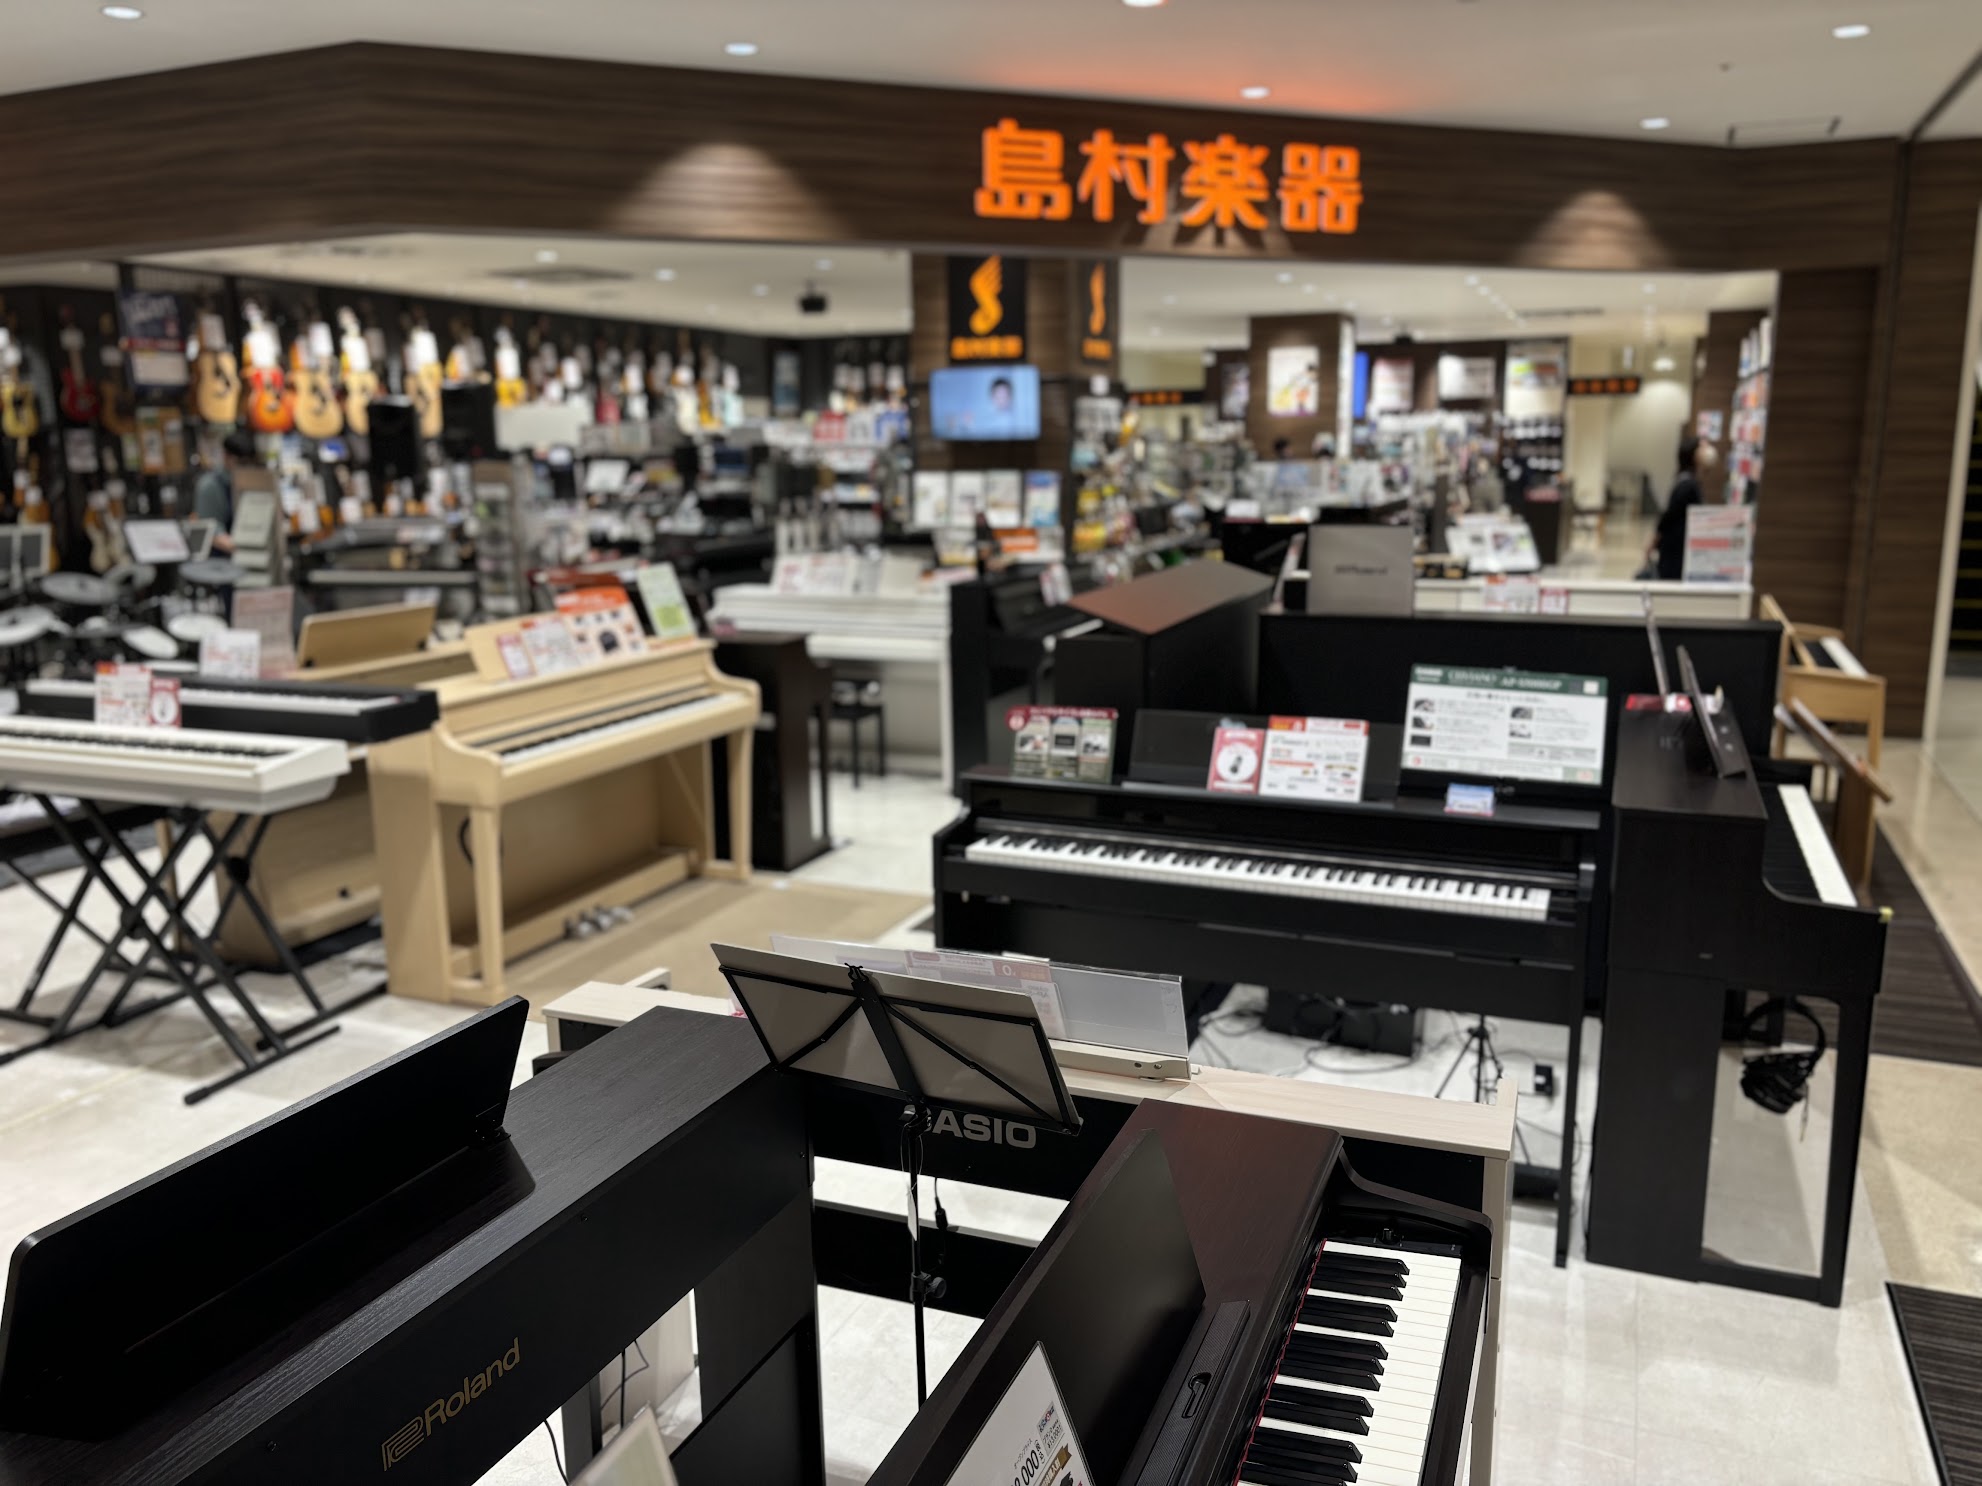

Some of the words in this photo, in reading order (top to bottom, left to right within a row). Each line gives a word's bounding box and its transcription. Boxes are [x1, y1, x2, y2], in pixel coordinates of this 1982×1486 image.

[974, 117, 1362, 234] 島村楽器
[424, 1336, 521, 1437] Roland
